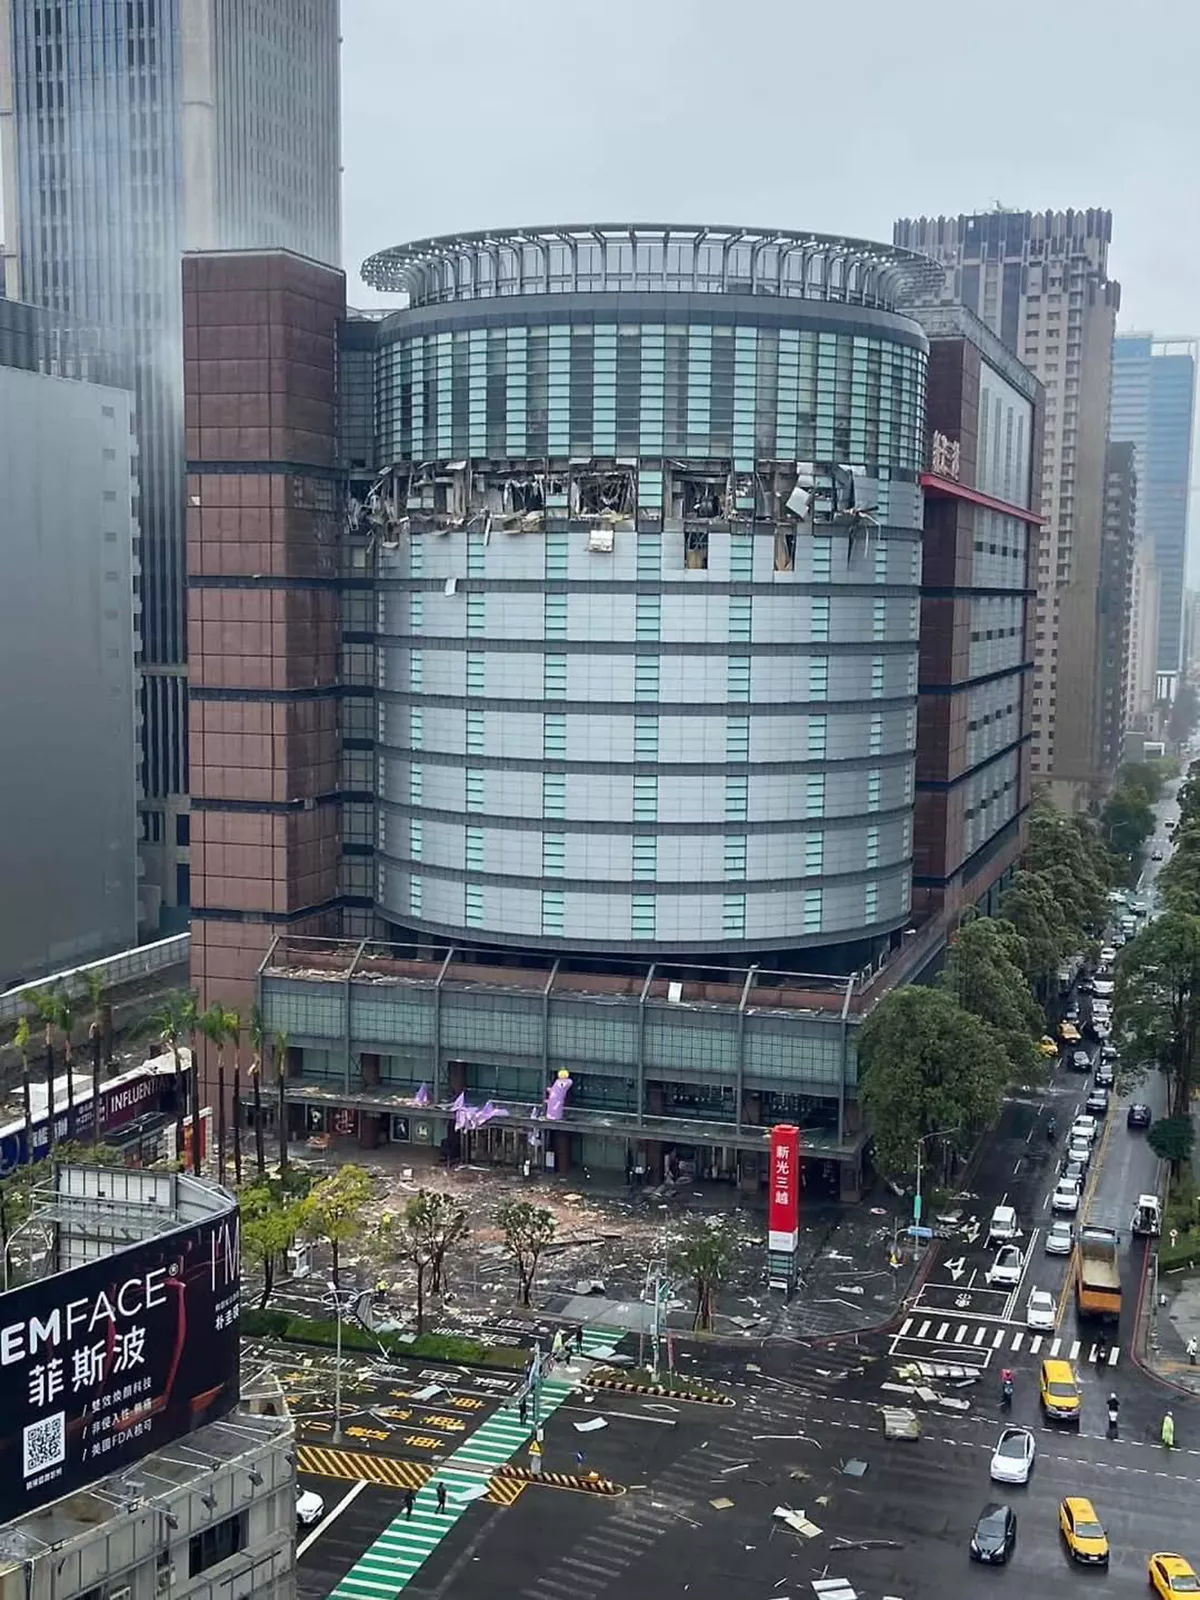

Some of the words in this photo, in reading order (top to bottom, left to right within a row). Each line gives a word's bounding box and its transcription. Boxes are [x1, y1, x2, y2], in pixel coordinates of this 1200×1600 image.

[775, 1145, 790, 1205] 新光三越
[28, 1325, 147, 1407] 菲斯波
